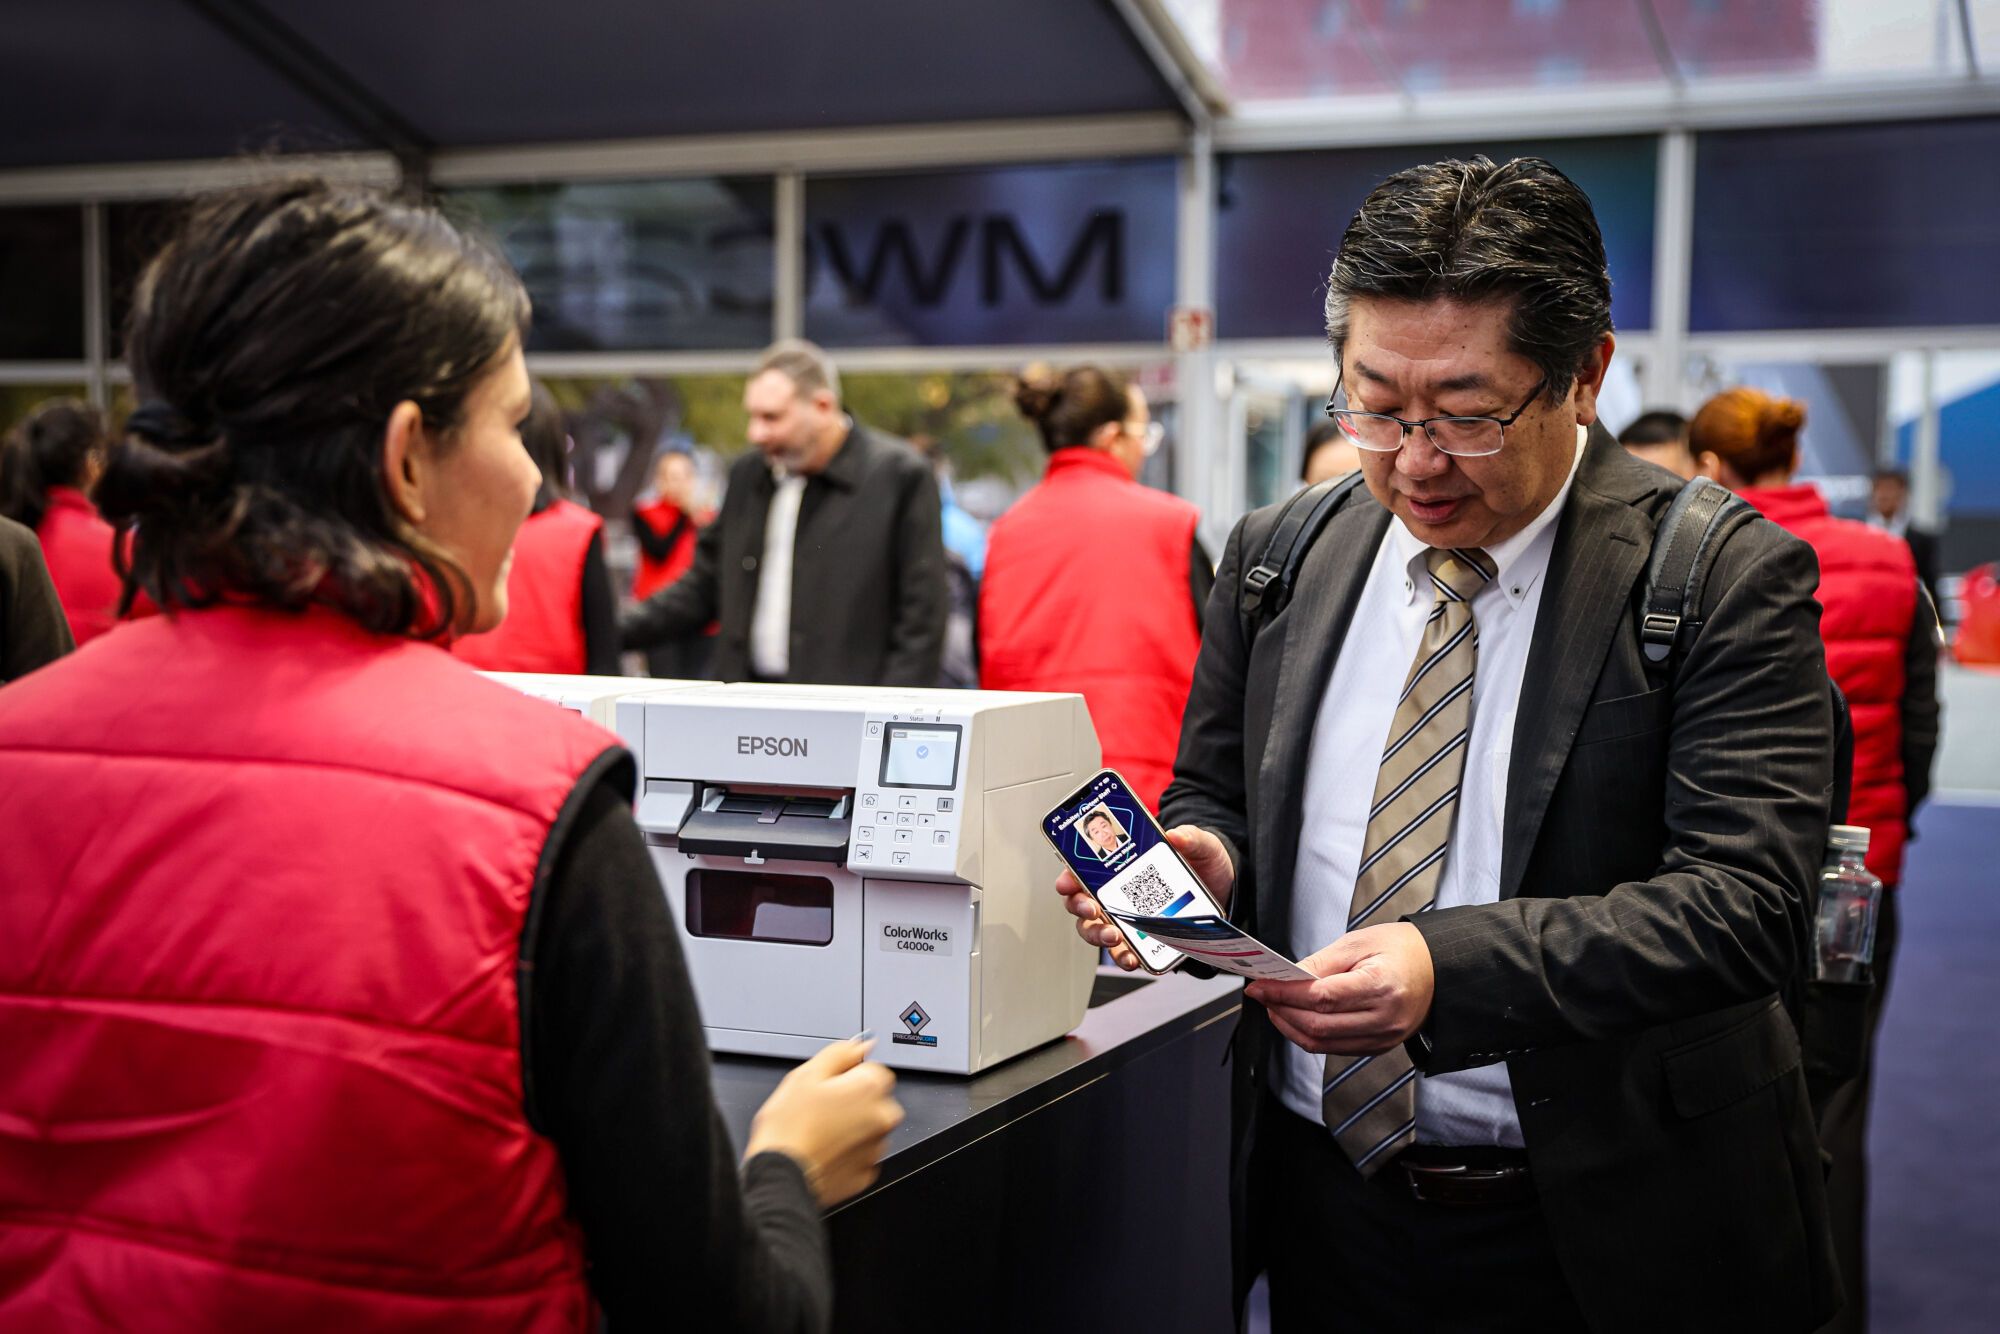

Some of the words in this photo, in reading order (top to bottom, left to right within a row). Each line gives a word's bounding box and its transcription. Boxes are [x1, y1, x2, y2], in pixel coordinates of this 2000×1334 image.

[737, 735, 808, 757] EPSON
[1082, 797, 1100, 812] Partner
[1098, 787, 1111, 799] Staff
[883, 925, 948, 941] ColorWorks
[897, 940, 935, 952] C4000e
